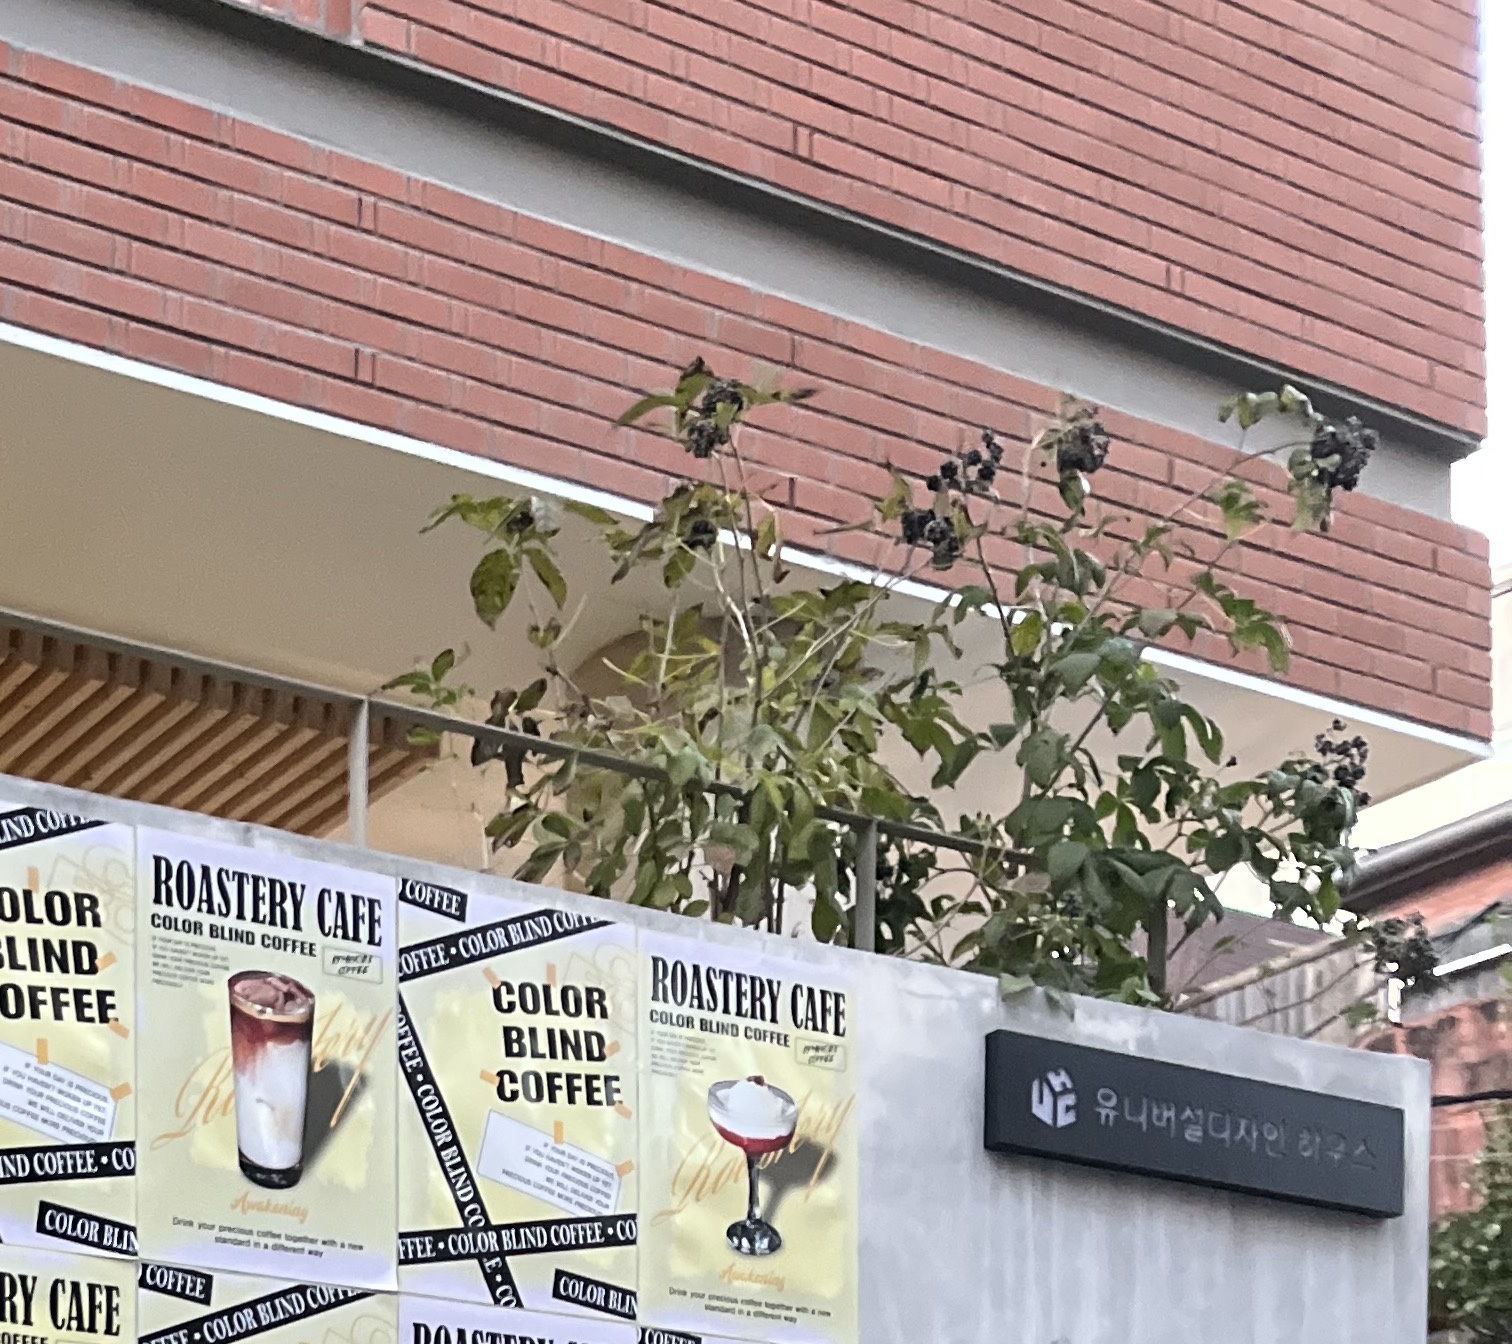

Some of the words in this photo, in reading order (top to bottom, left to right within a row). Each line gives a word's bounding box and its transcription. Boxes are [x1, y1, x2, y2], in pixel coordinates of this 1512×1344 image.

[152, 854, 306, 932] ROASTERY
[316, 887, 382, 947] CAFE
[151, 912, 203, 936] COLOR
[209, 923, 255, 946] BLIND
[260, 933, 316, 957] COFFEE
[457, 926, 510, 958] COLOR
[506, 915, 553, 945] BLIND
[491, 981, 608, 1019] COLOR
[651, 955, 781, 1025] ROASTERY
[790, 983, 846, 1037] CAFE
[501, 1025, 606, 1062] BLIND
[649, 1008, 694, 1030] COLOR
[699, 1017, 738, 1038] BLIND
[743, 1026, 790, 1048] COFFEE
[494, 1069, 622, 1106] COFFEE
[31, 1148, 99, 1175] COFFEE
[416, 1084, 453, 1147] COLOR
[440, 1145, 474, 1202] BLIND
[44, 1208, 101, 1243] COLOR
[447, 1230, 500, 1255] COLOR
[499, 1226, 547, 1250] BLIND
[548, 1220, 605, 1246] COFFEE
[144, 1264, 206, 1298] COFFEE
[558, 1275, 607, 1307] COLOR
[49, 1278, 120, 1336] CAFE
[202, 1307, 259, 1343] COLOR
[255, 1292, 306, 1326] BLIND
